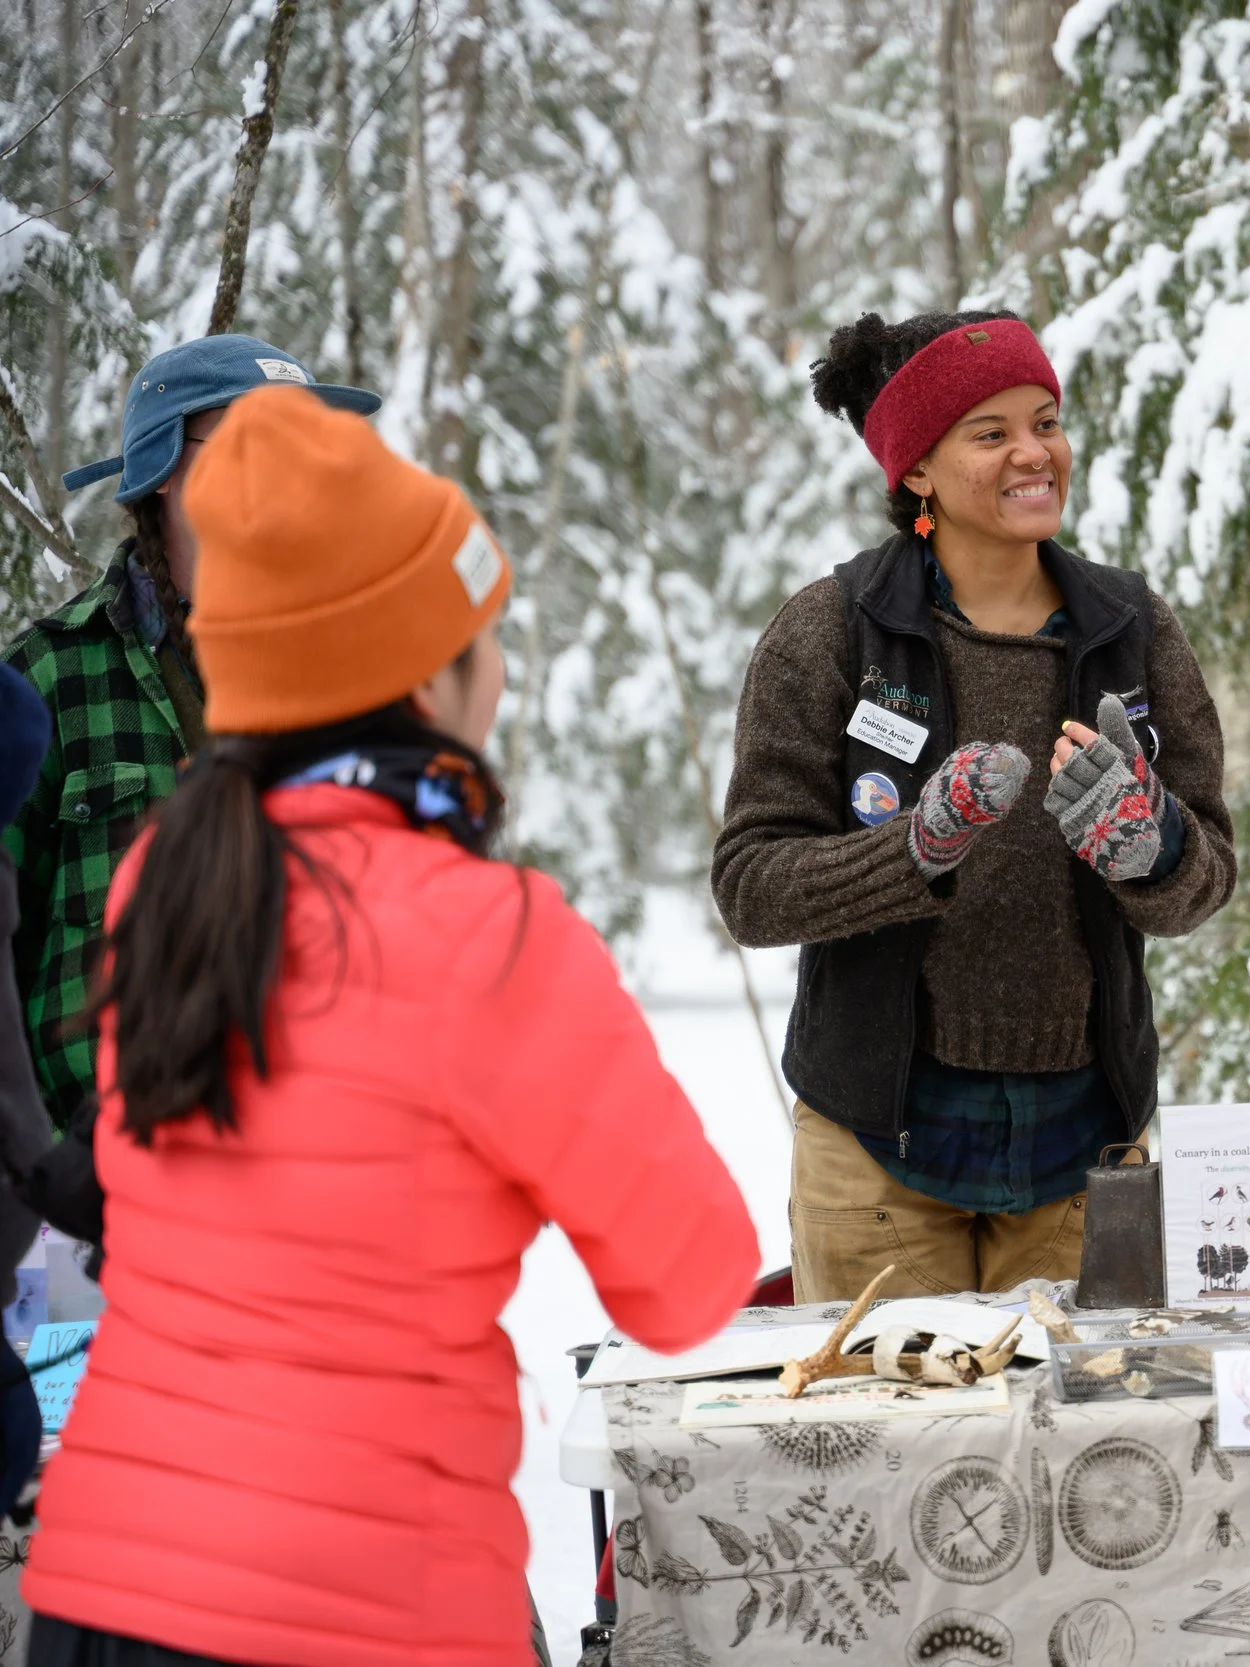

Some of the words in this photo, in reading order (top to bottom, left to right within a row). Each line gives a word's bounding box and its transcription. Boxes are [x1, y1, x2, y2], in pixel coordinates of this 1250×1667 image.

[856, 728, 884, 745] Education
[884, 741, 908, 757] Manager
[860, 716, 888, 734] Debbie
[888, 730, 915, 747] Archer
[1174, 1149, 1209, 1160] Canary
[1211, 1147, 1221, 1157] in
[1230, 1146, 1250, 1156] coal
[885, 1450, 901, 1472] 20
[734, 1480, 749, 1513] 1204
